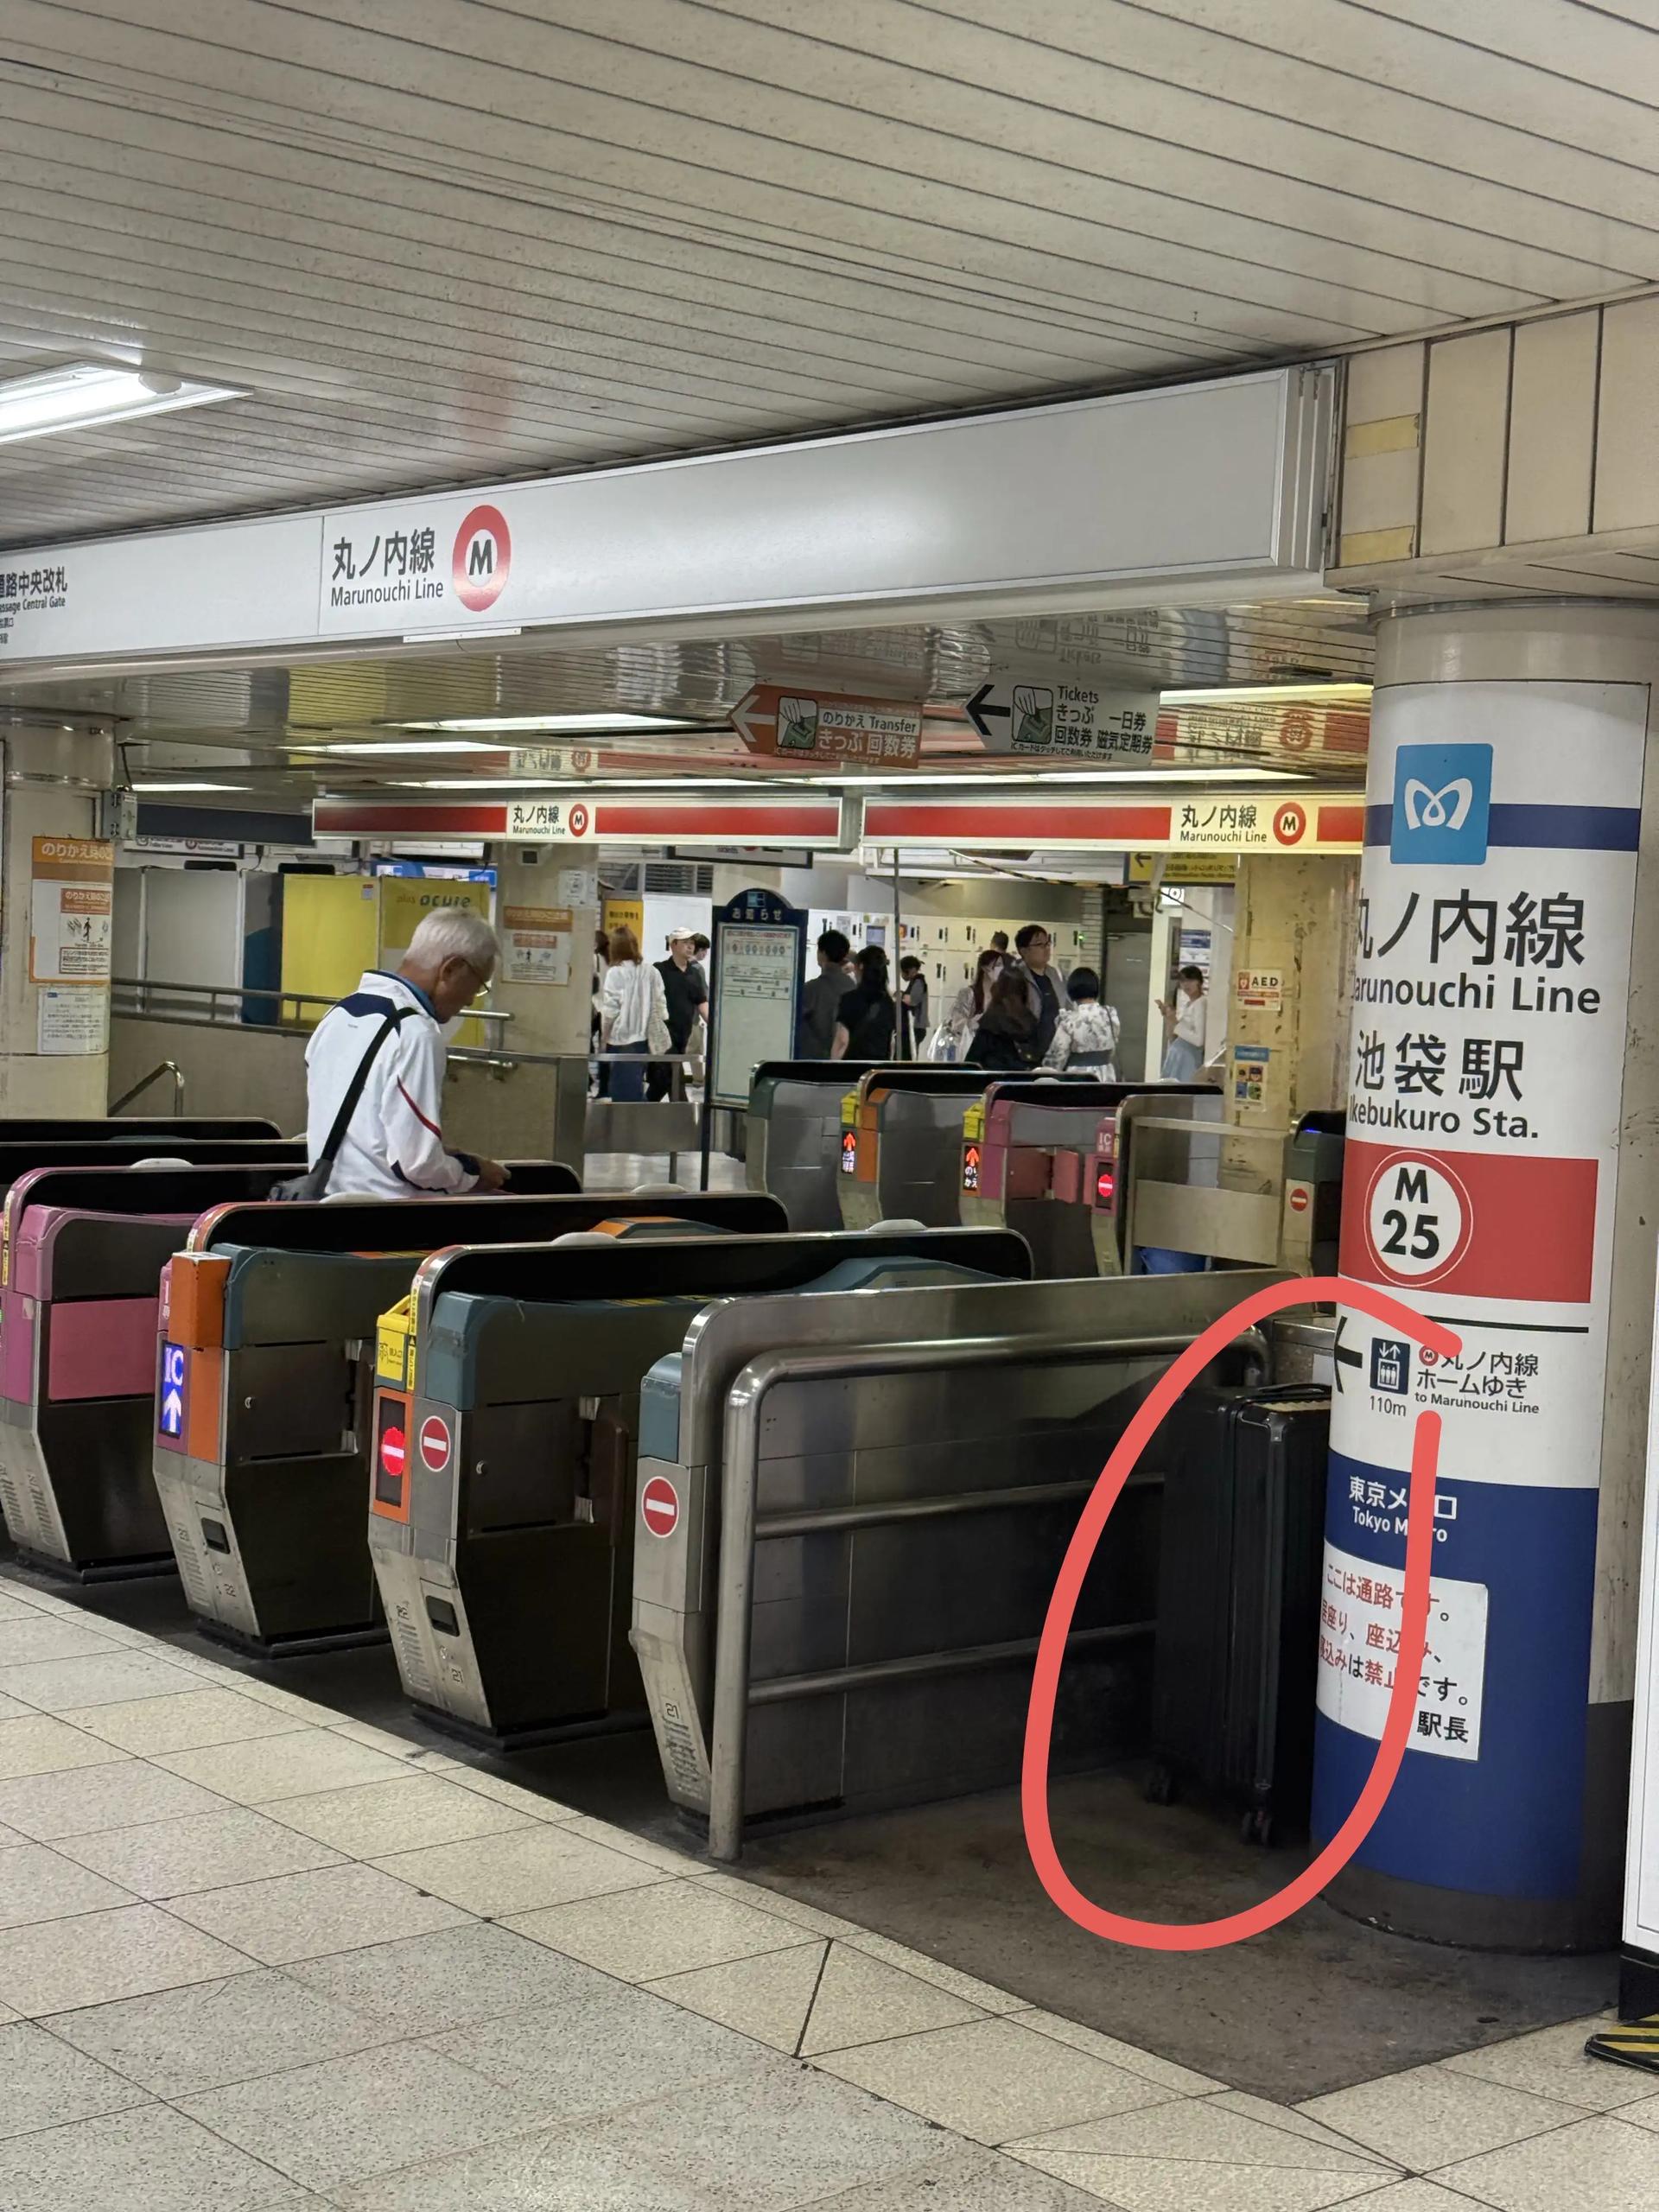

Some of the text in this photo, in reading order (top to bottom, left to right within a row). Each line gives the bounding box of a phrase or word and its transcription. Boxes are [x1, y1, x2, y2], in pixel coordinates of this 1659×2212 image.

[332, 527, 435, 581] 丸ノ内線
[468, 539, 493, 575] M
[22, 595, 48, 610] Central
[49, 595, 66, 608] Gate
[331, 578, 444, 607] Marunouchi Line
[1058, 686, 1099, 704] Tickets
[823, 711, 917, 734] のりかえ Transfer
[1056, 704, 1147, 731] きっぷ 一日券
[819, 729, 863, 753] きっぷ
[867, 734, 917, 759] 回数券
[1054, 726, 1093, 747] 回数券
[513, 805, 559, 823] 丸ノ内線
[575, 815, 582, 825] M
[1181, 804, 1257, 829] 丸ノ内線
[1282, 816, 1296, 831] M
[512, 825, 566, 835] Marunouchi Line
[1180, 830, 1267, 842] Marunouchi Line
[420, 894, 471, 907] acure
[1252, 976, 1278, 987] AED
[1354, 973, 1601, 1014] arunouchi Line
[1356, 1029, 1523, 1102] 池袋駅
[1349, 1093, 1538, 1139] Ikebukuro Sta.
[1099, 1133, 1112, 1146] IC
[1395, 1167, 1429, 1204] M
[1381, 1210, 1440, 1260] 25
[164, 1347, 184, 1386] IC
[1441, 1351, 1539, 1376] 丸ノ内線
[1417, 1369, 1528, 1399] ホームゆき
[1370, 1395, 1407, 1417] 110m
[1414, 1392, 1540, 1414] to Marunouchi Line
[1349, 1476, 1458, 1520] 東京メロ
[1352, 1506, 1448, 1542] Tokyo Mro
[1326, 1564, 1449, 1622] ここは通路。
[1417, 1711, 1469, 1744] 駅長
